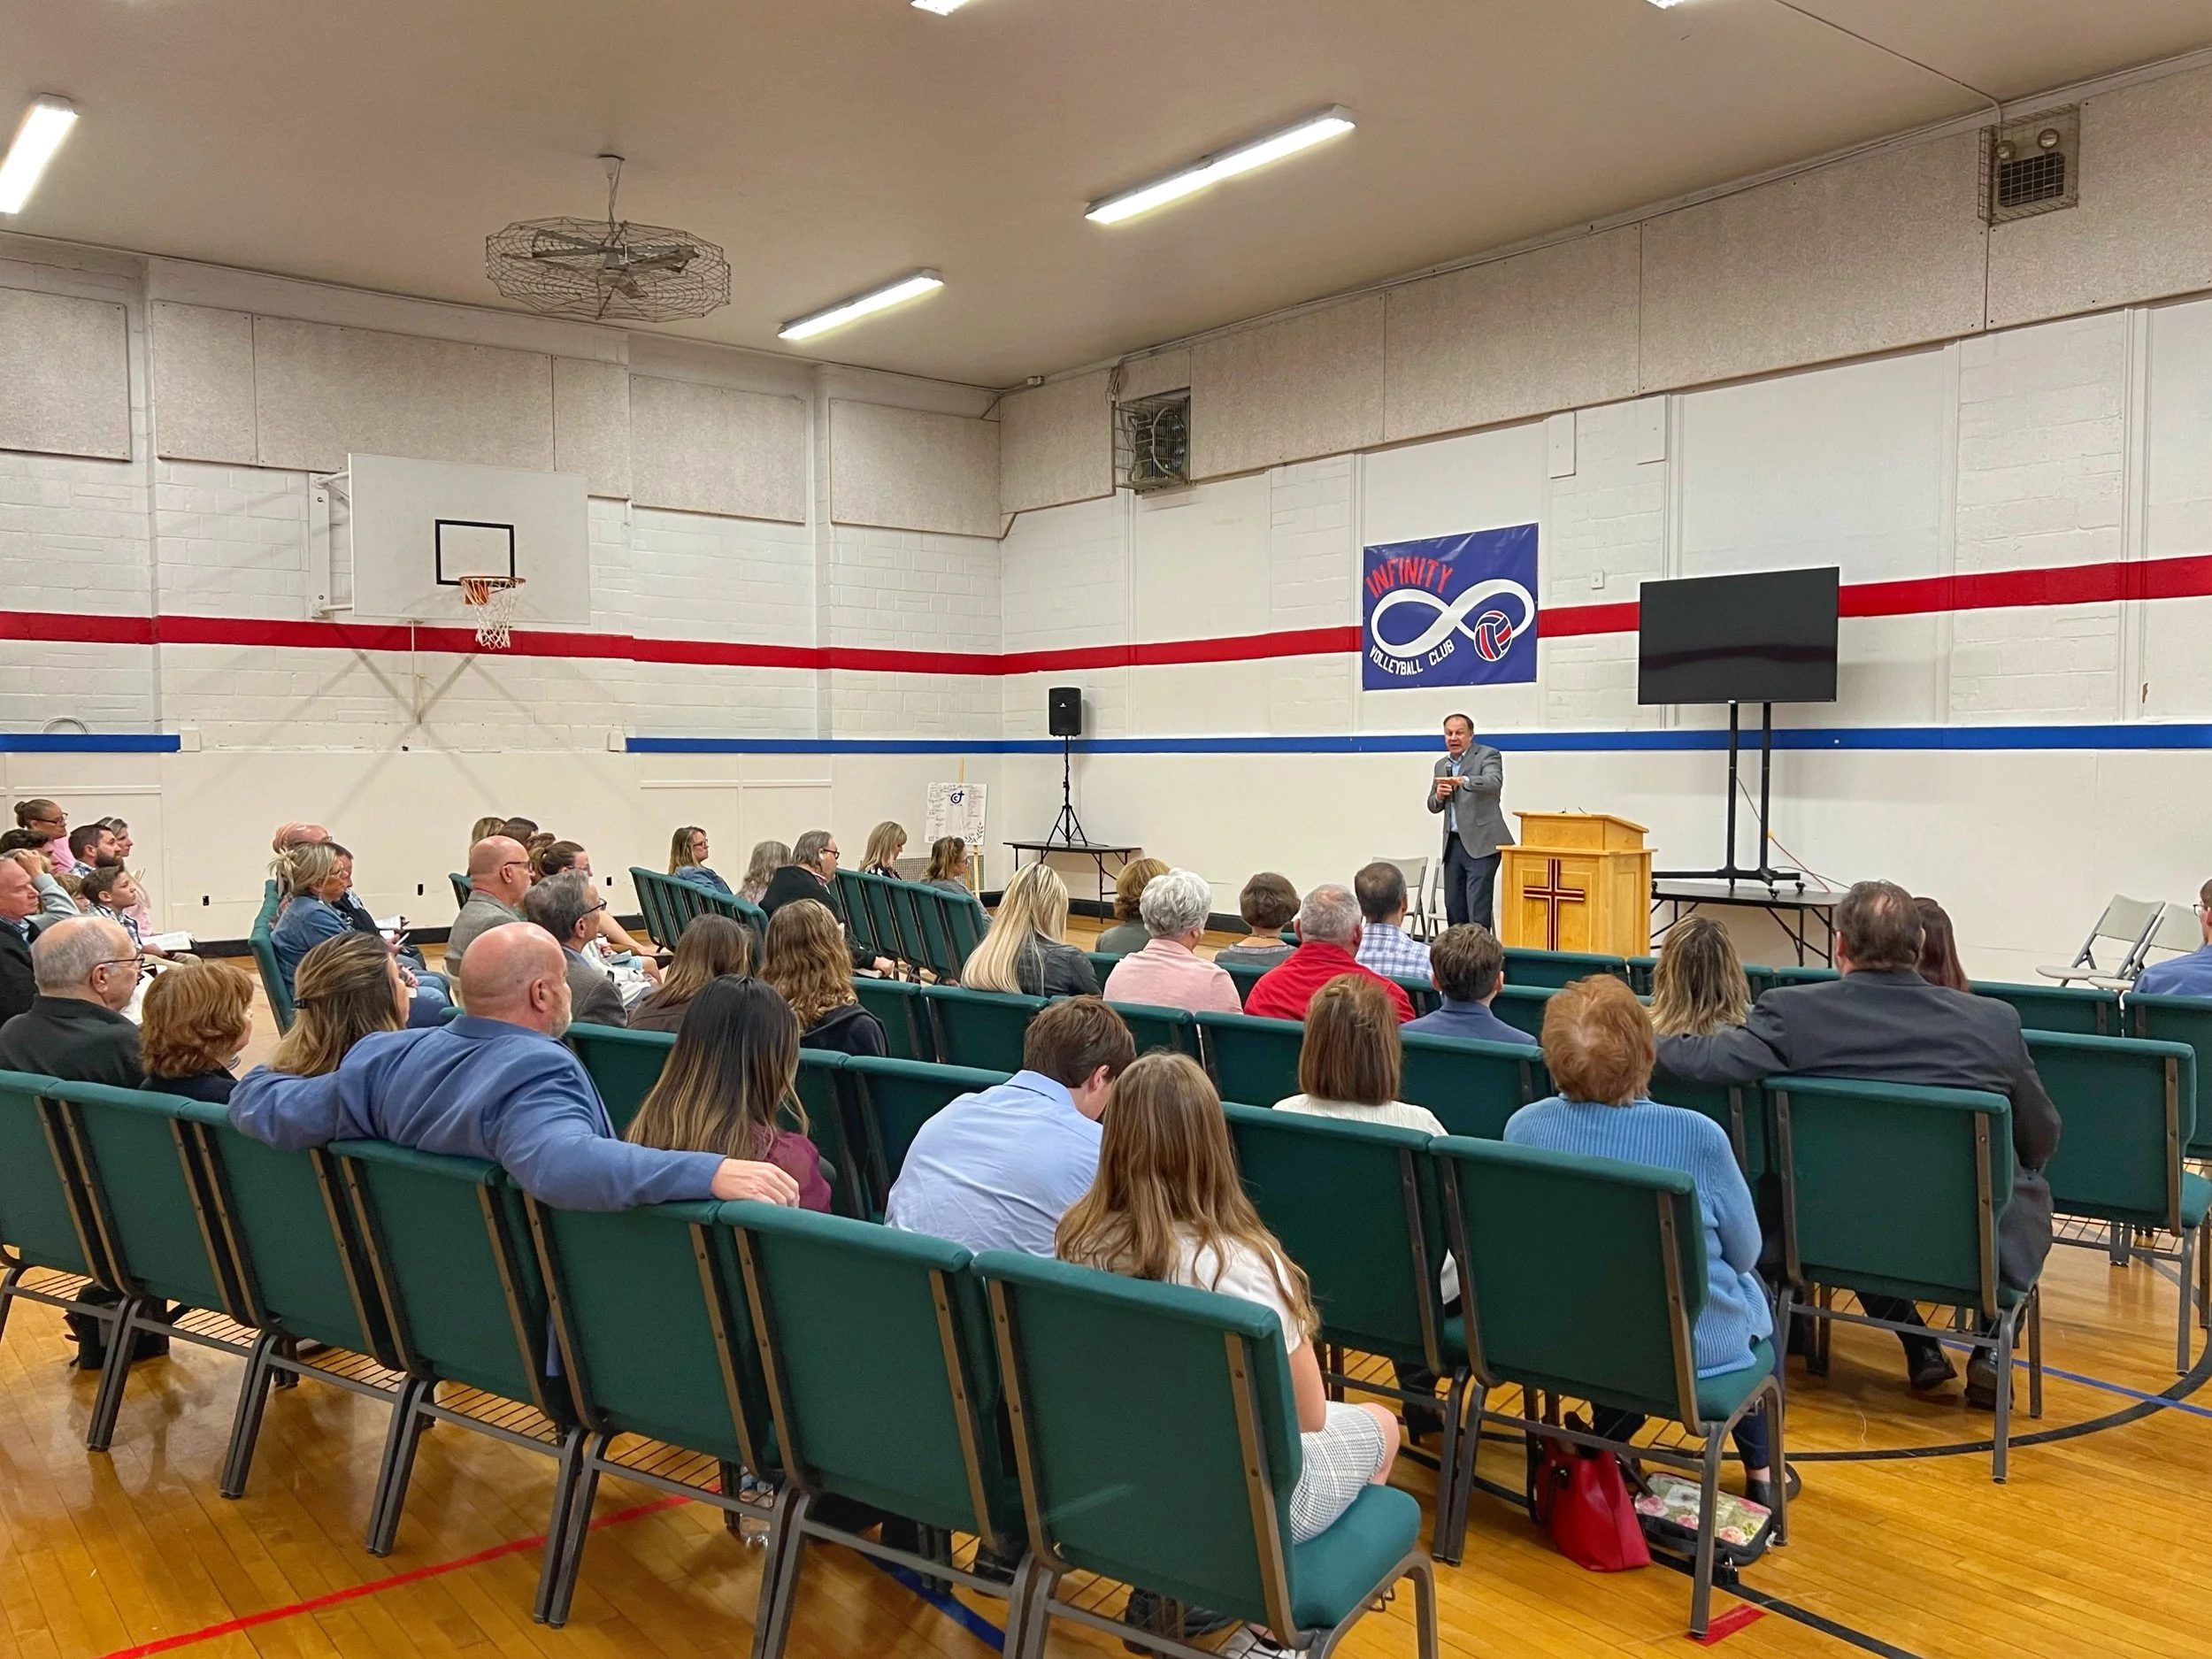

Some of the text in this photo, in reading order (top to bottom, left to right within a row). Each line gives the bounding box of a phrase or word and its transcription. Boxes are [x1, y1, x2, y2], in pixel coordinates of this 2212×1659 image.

[1366, 557, 1453, 598] INFINITY
[1369, 639, 1455, 675] VOLLEYBALL CLUB
